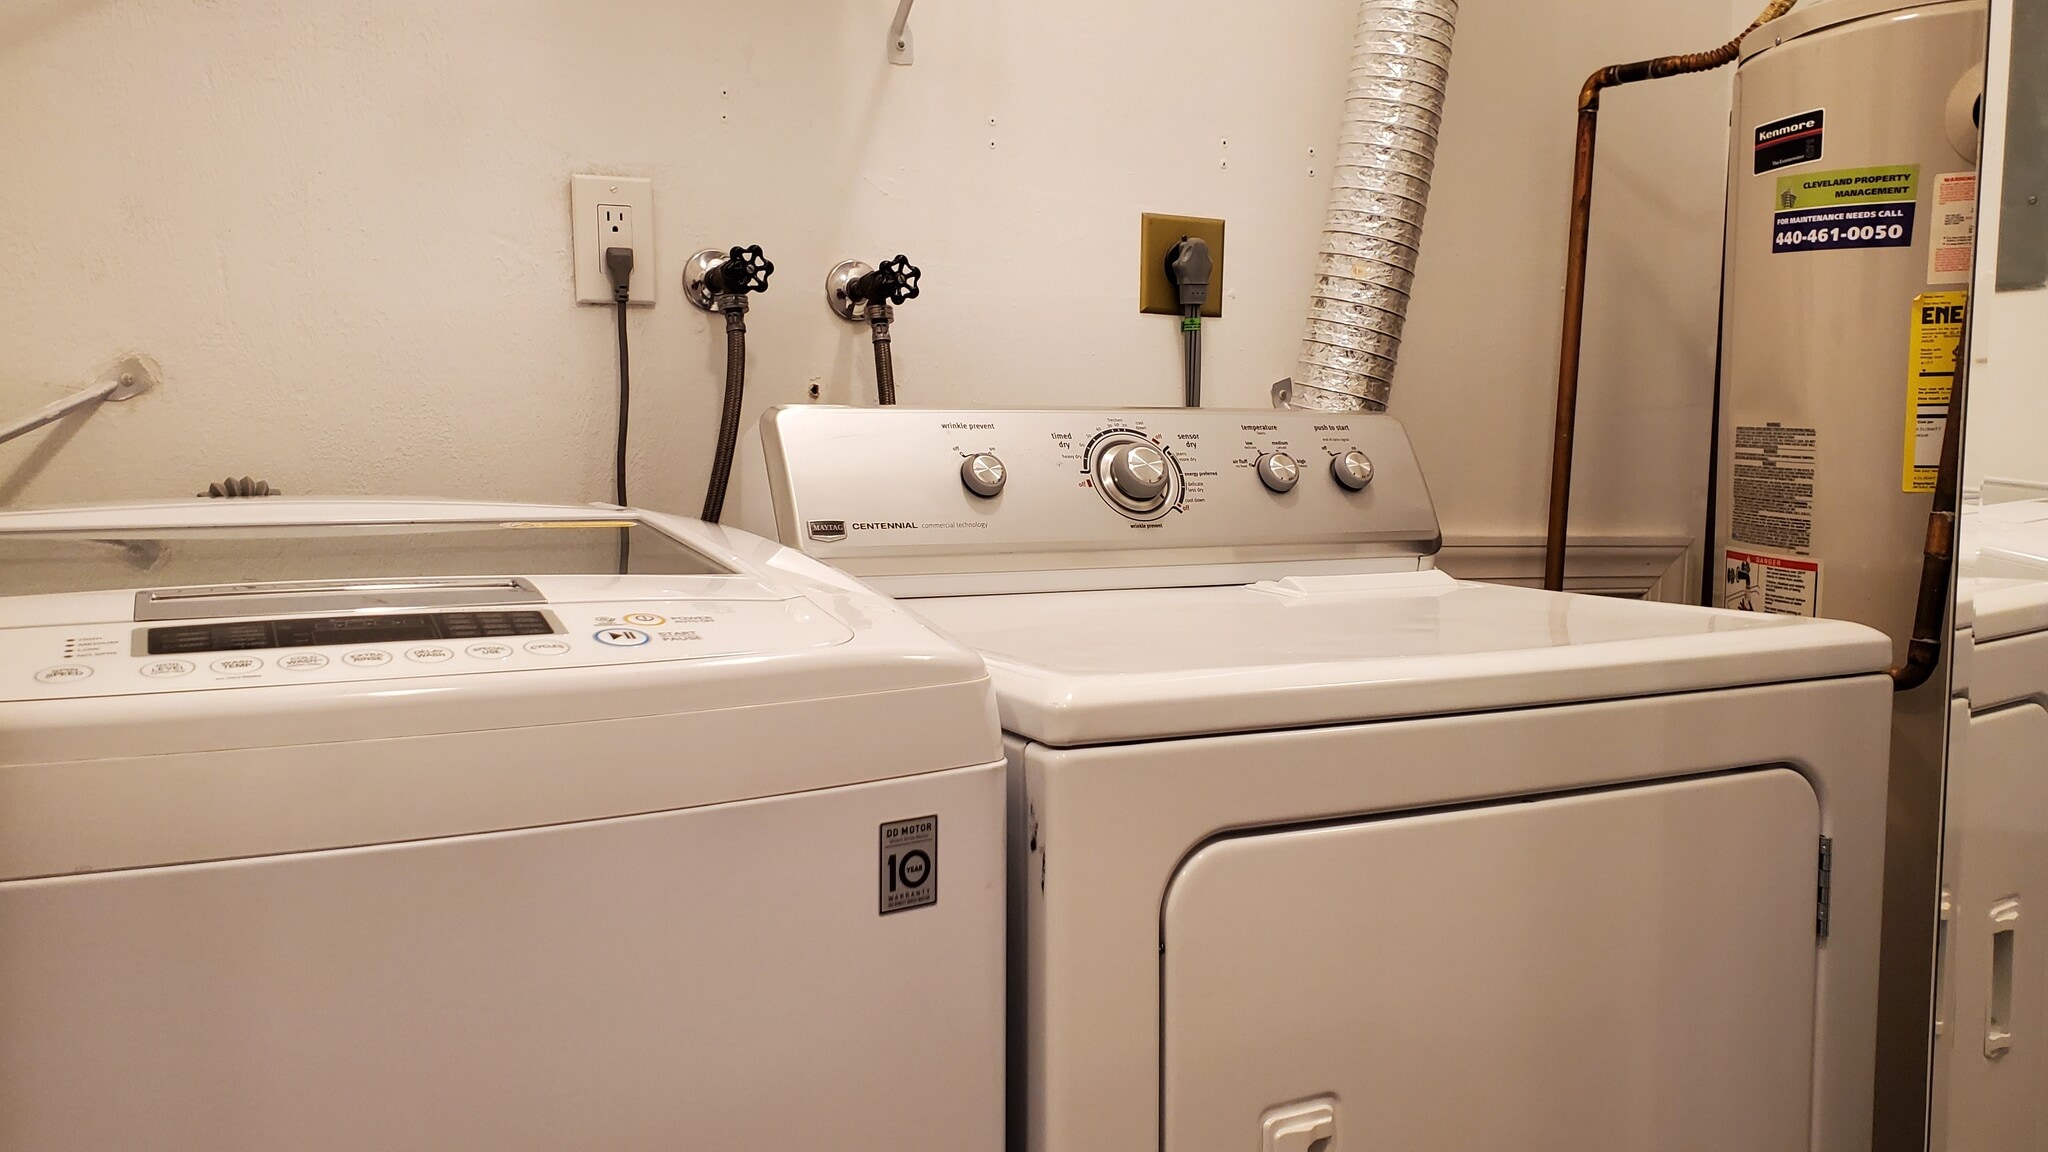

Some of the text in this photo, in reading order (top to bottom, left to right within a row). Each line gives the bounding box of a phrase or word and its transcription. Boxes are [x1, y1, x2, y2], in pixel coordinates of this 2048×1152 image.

[1759, 119, 1815, 141] Kenmore
[1803, 173, 1911, 189] CLEVELAND PROPERTY
[1835, 186, 1910, 198] MANAGEMENT
[1777, 209, 1904, 226] FOR MAINTENANCE NEEDS CALL
[1776, 224, 1904, 246] 440-461-0050
[941, 422, 995, 431] wrinkle prevent
[1051, 432, 1073, 440] timed
[1058, 441, 1070, 449] dry
[1186, 441, 1197, 449] dry
[812, 523, 844, 532] MAYTAG
[852, 522, 918, 530] CENTENNIAL
[956, 521, 988, 529] technology
[1756, 556, 1781, 566] DANGER
[886, 828, 899, 838] DD
[901, 822, 932, 835] MOTOR
[888, 849, 931, 892] 10
[906, 864, 923, 873] YEAR
[888, 888, 930, 901] WARRANTY
